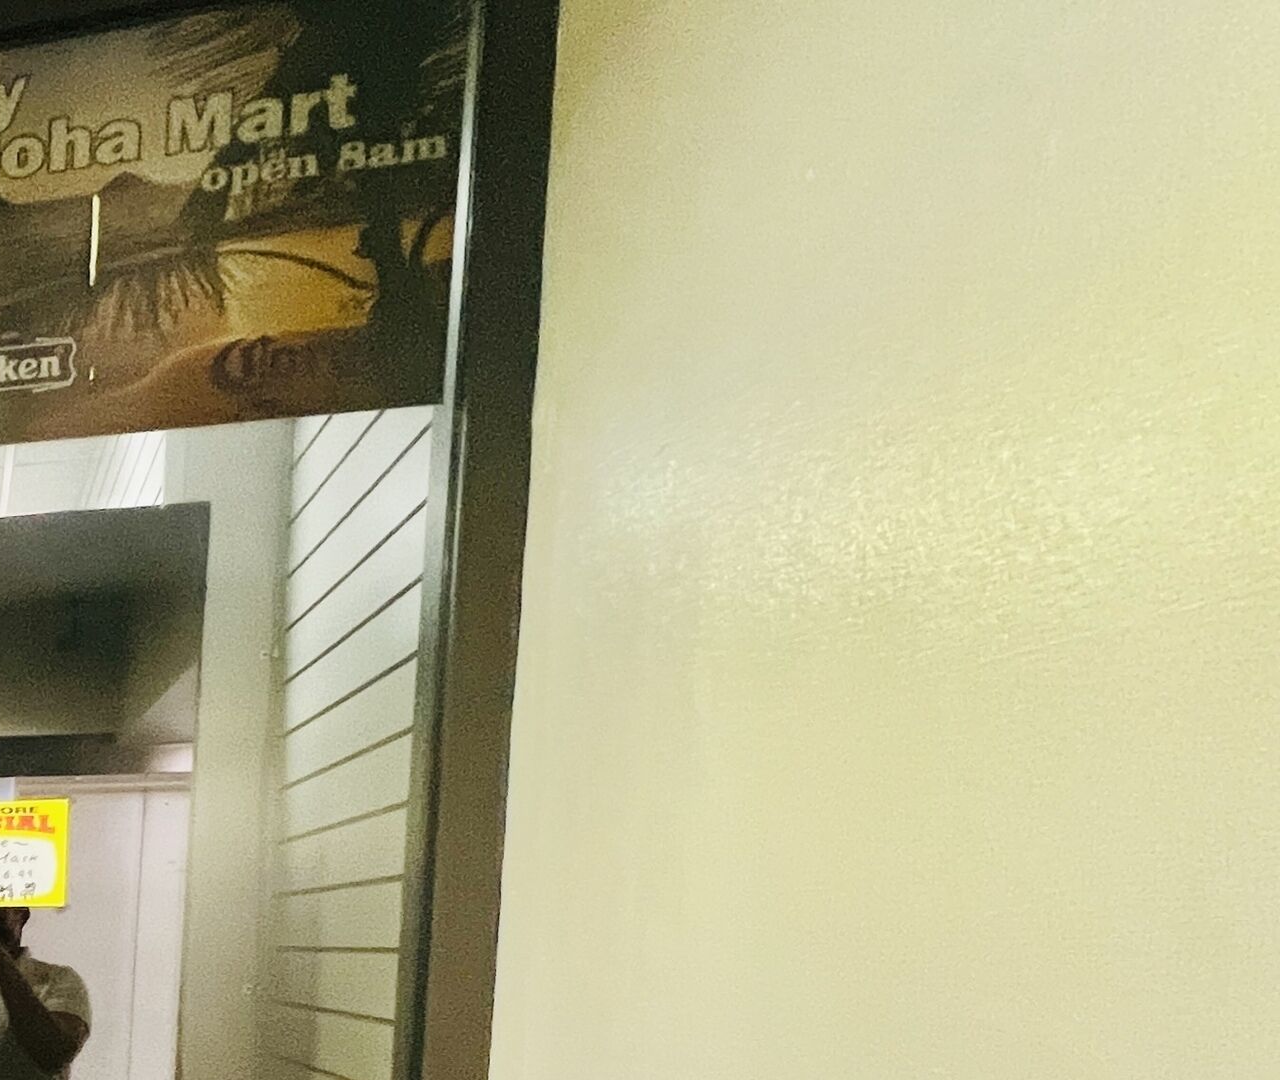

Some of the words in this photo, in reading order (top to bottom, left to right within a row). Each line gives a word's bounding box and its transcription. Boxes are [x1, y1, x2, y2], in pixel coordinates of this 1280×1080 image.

[164, 72, 359, 156] Mart
[200, 152, 320, 197] open
[338, 132, 448, 170] 8am
